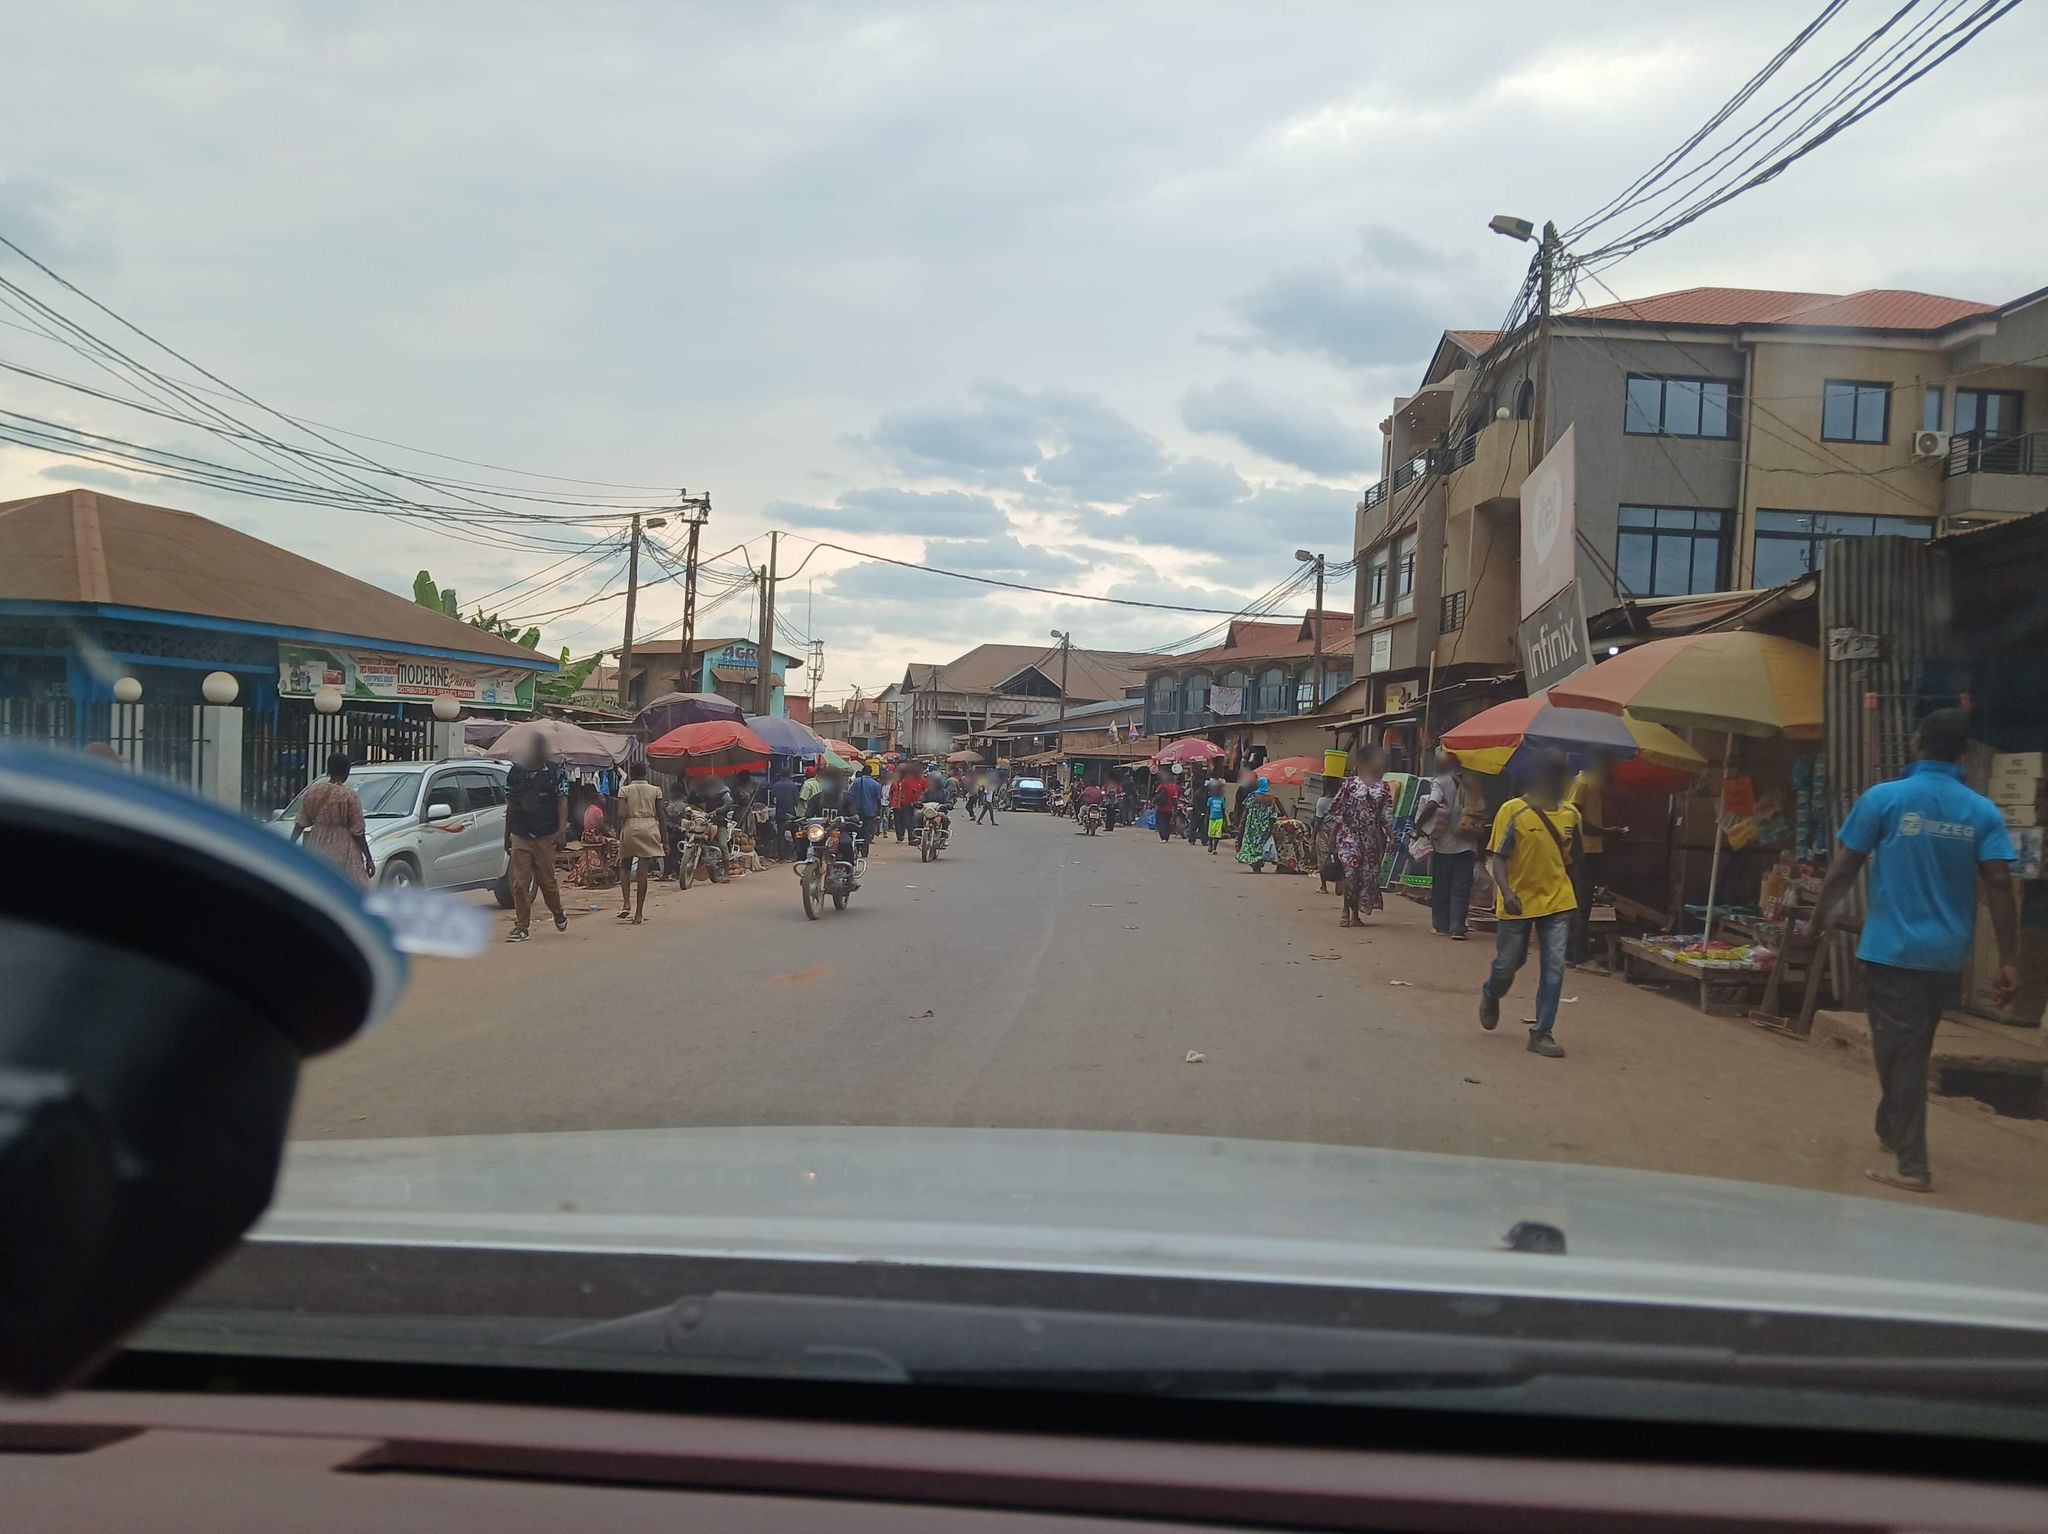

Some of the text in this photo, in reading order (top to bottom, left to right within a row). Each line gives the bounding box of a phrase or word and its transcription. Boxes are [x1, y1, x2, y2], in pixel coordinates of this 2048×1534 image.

[721, 646, 758, 660] AGR
[1527, 612, 1579, 679] Infinix
[397, 664, 449, 687] MODERNE
